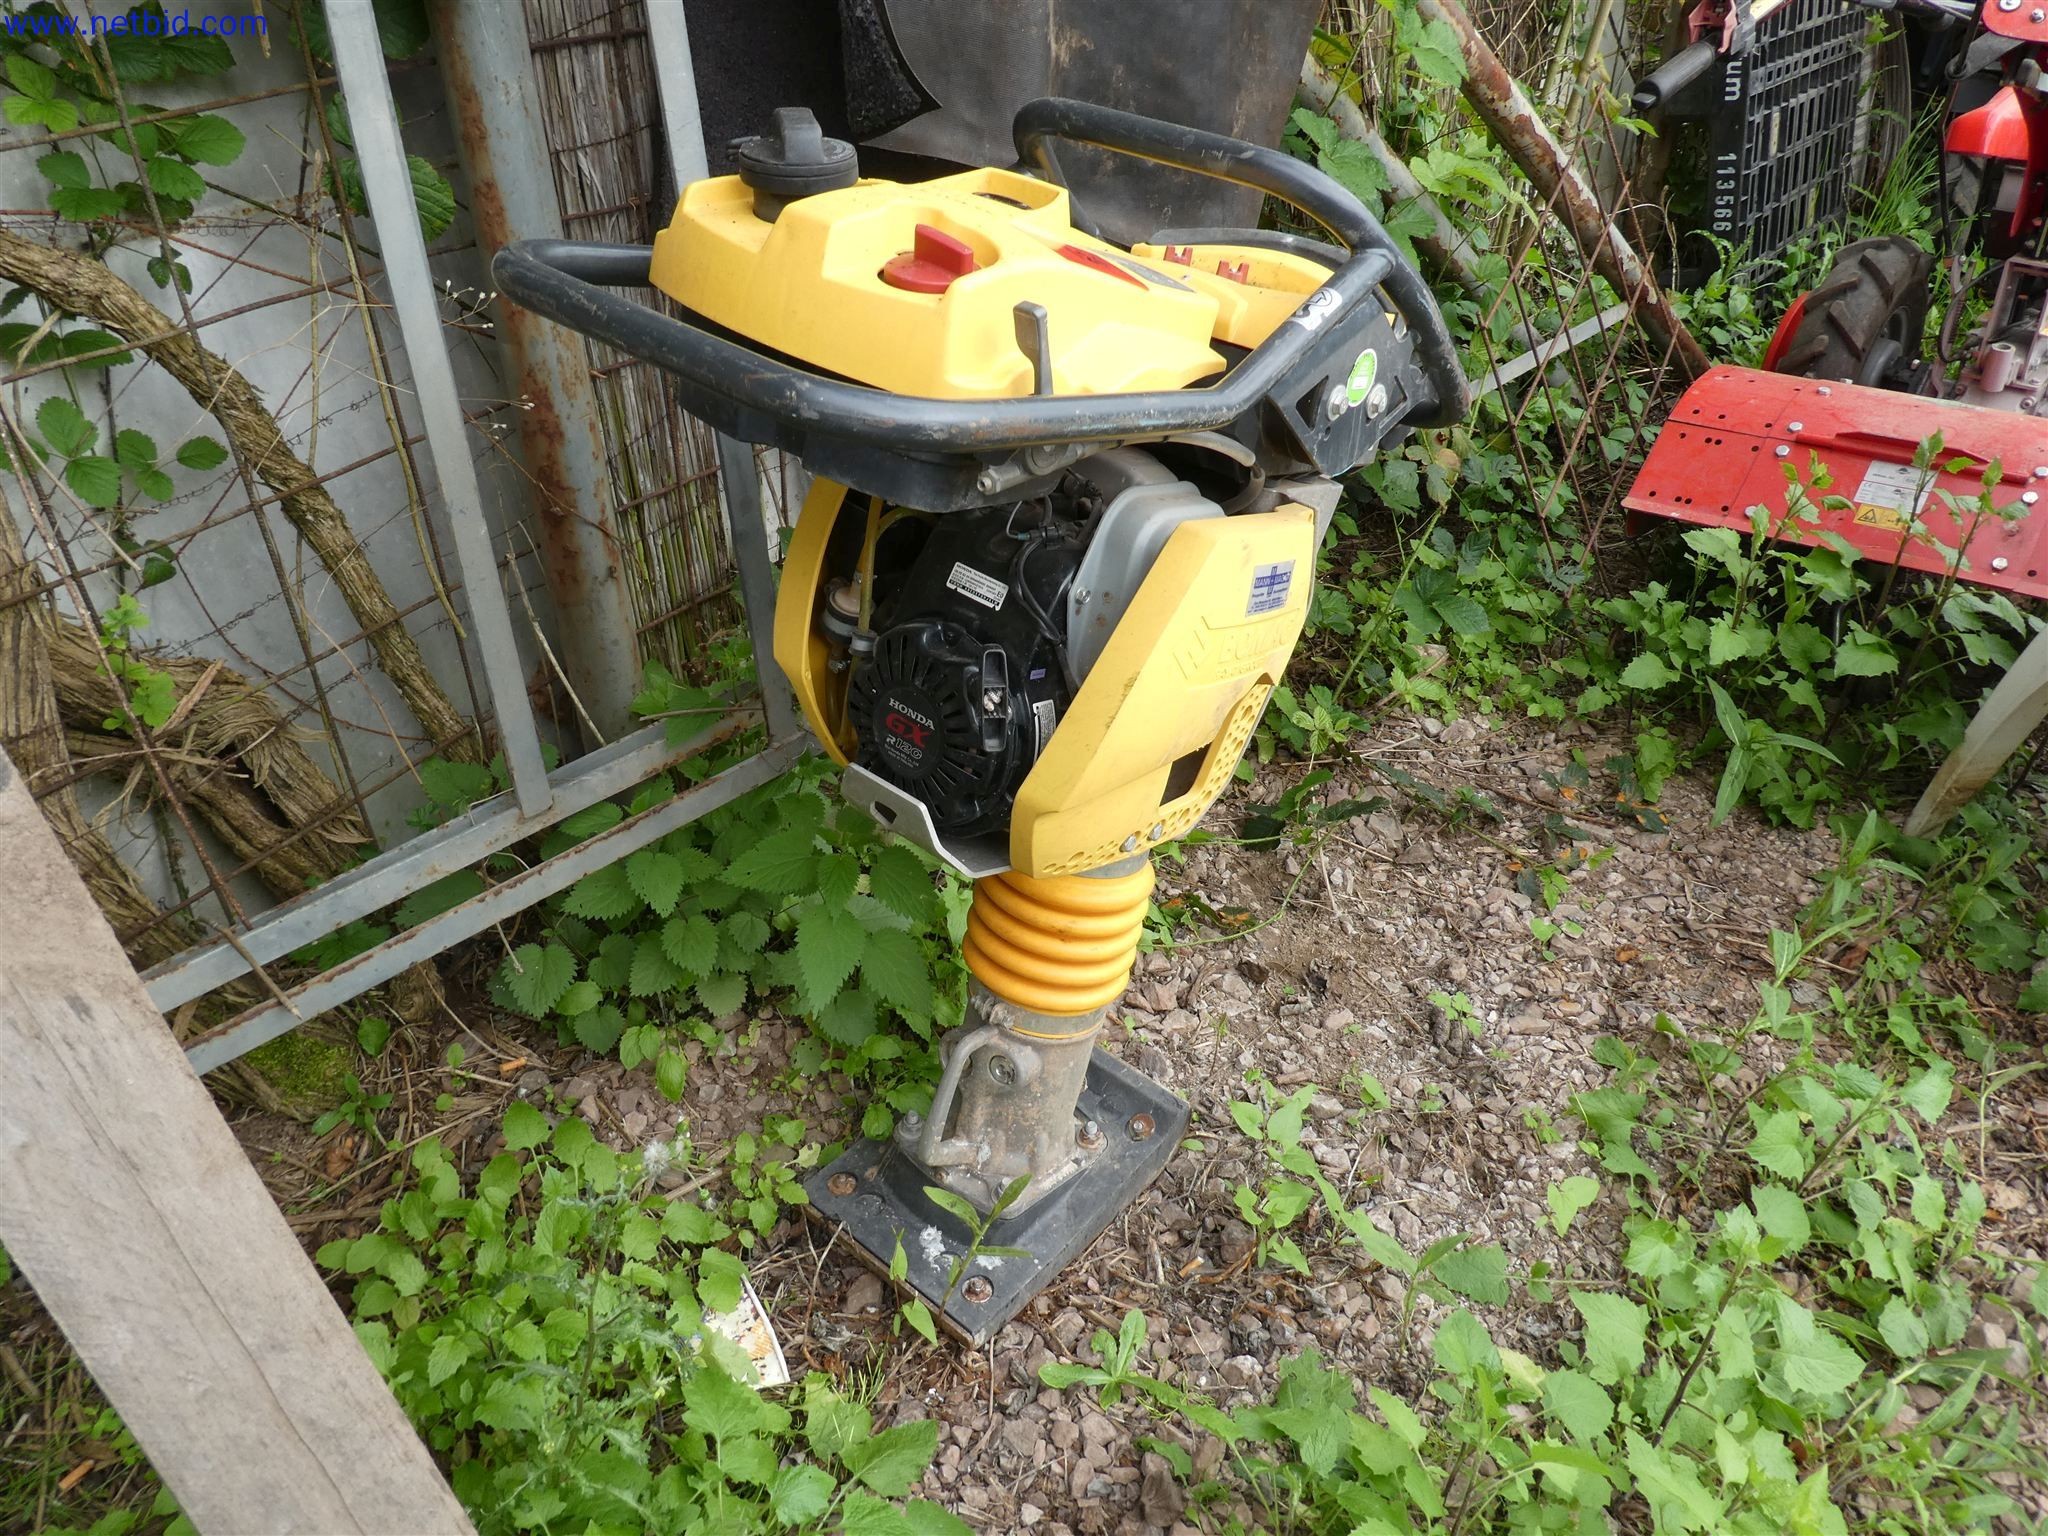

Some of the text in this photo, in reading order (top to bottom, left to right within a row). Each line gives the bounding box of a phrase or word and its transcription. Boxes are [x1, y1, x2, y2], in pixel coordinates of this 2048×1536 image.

[1724, 55, 1745, 101] um
[1713, 153, 1737, 231] 113566
[886, 711, 932, 749] GX
[888, 697, 935, 730] HONDA
